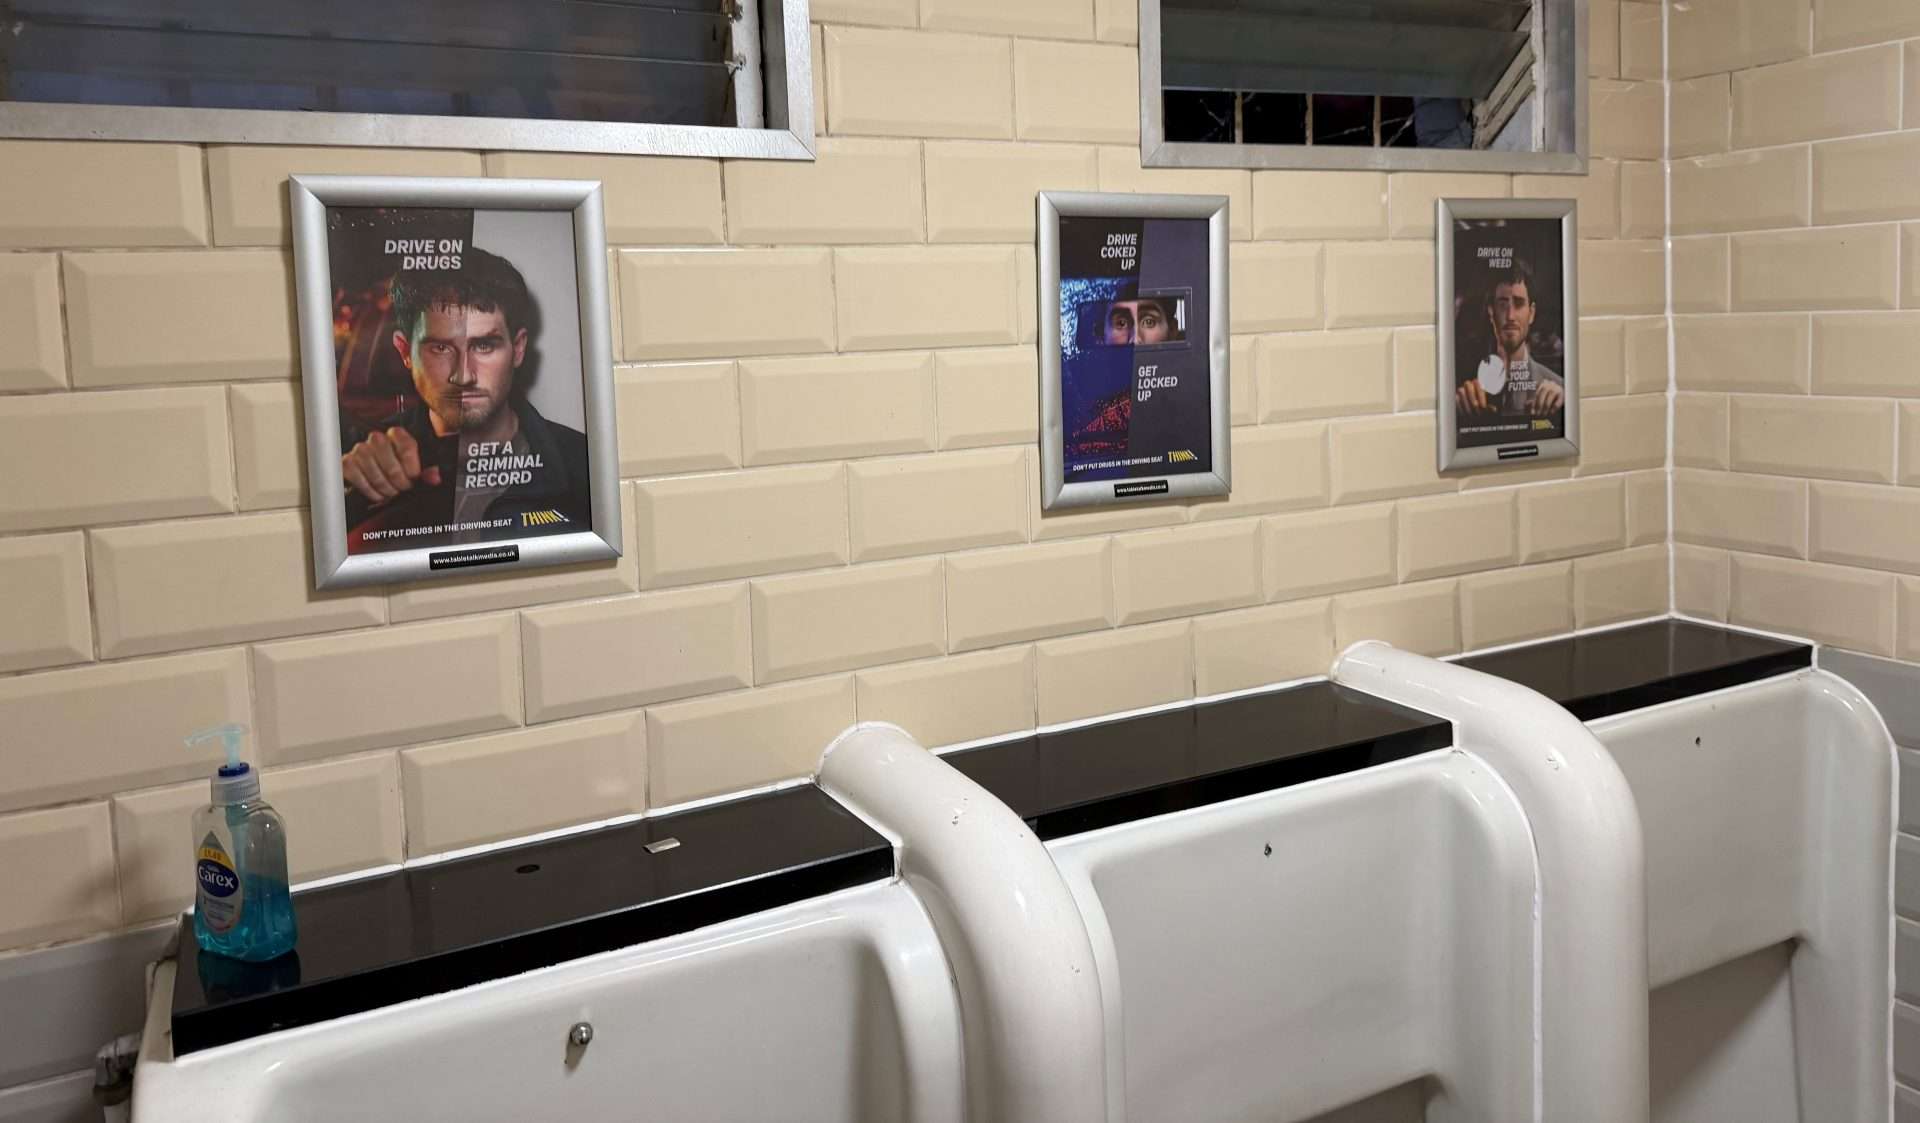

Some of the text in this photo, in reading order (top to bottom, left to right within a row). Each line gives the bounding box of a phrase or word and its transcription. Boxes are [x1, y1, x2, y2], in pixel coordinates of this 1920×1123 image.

[1106, 233, 1138, 246] DRIVE
[384, 239, 464, 254] DRIVE ON
[1100, 246, 1137, 259] COKED
[1477, 247, 1513, 257] DRIVE ON
[402, 255, 462, 270] DRUGS
[1121, 258, 1136, 270] UP
[1488, 258, 1512, 269] WEED
[1138, 365, 1158, 378] GET
[1137, 376, 1178, 390] LOCKED
[1508, 381, 1537, 392] FUTURE
[1137, 390, 1152, 402] UP
[467, 440, 514, 457] GET A
[466, 453, 544, 473] CRIMINAL
[465, 470, 532, 489] RECORD
[362, 518, 512, 541] DON'T PUT DRUGS IN THE DRIVING SEAT
